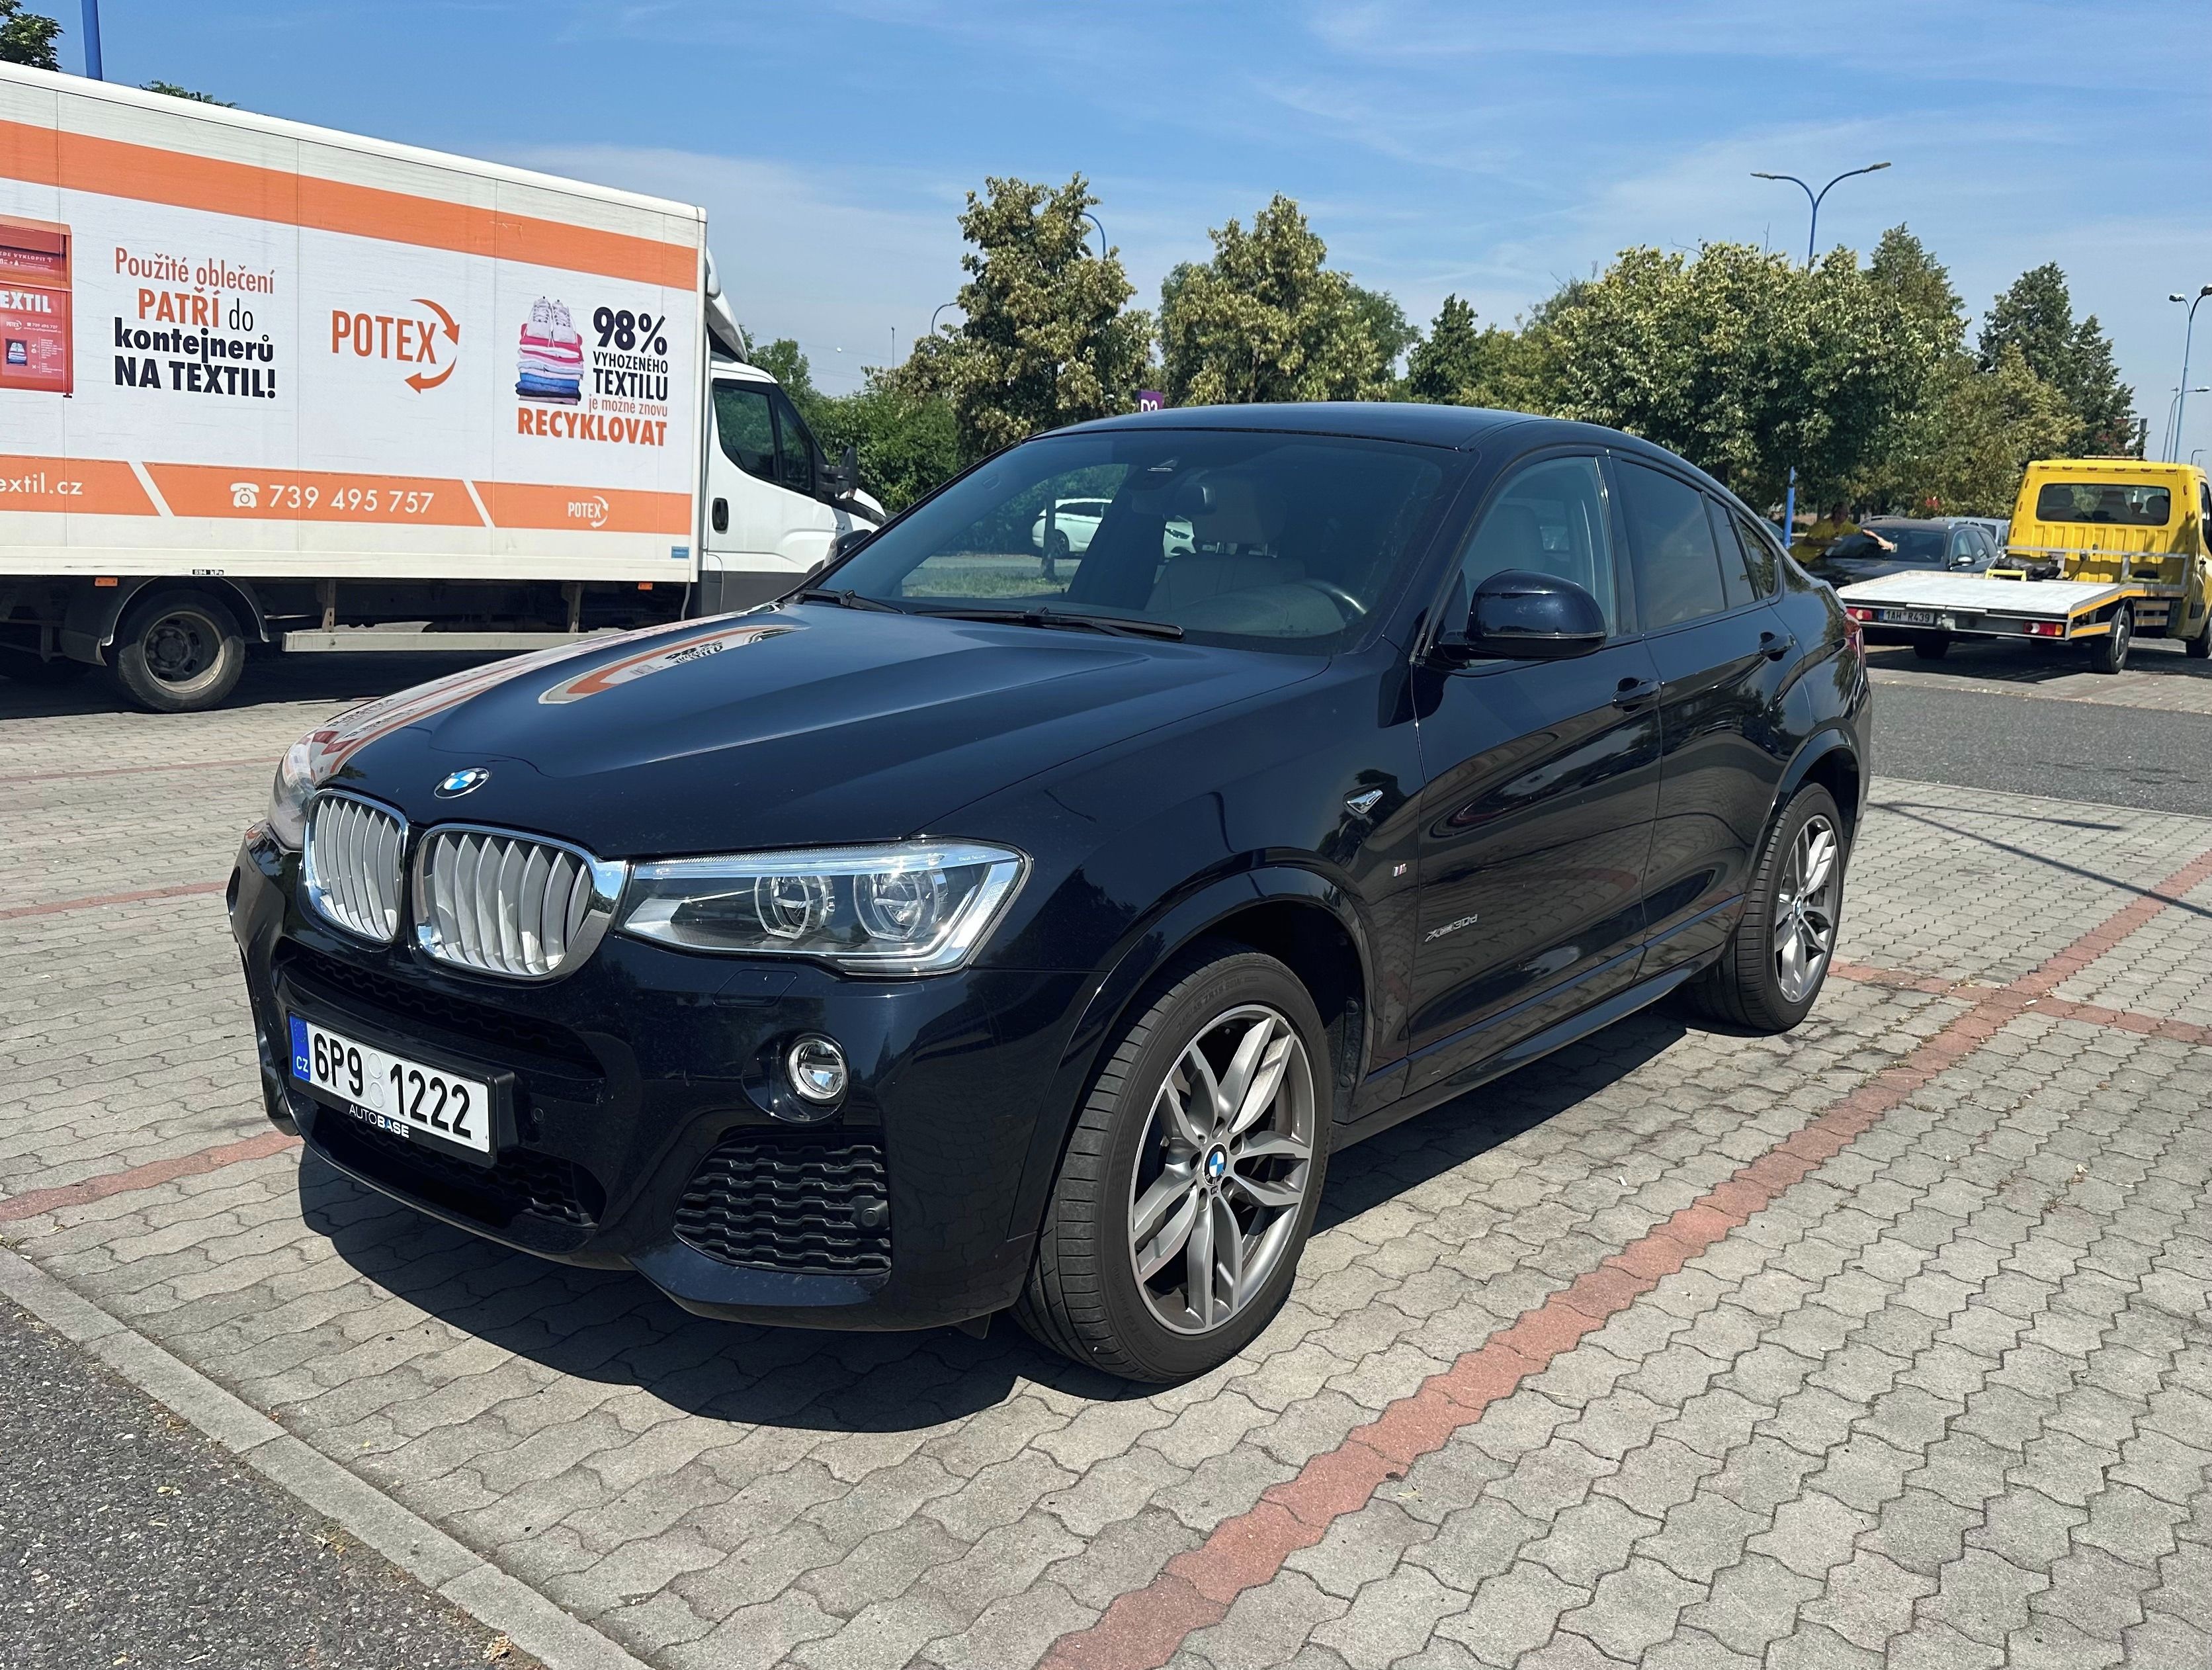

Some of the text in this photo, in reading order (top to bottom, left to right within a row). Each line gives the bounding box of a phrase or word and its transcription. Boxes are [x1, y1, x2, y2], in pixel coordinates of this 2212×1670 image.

[115, 247, 275, 294] Použité oblečení
[138, 286, 253, 331] PATŘÍ do
[114, 316, 274, 363] kontejnerů
[332, 310, 437, 365] POTEX
[593, 306, 667, 356] 98%
[114, 355, 276, 399] NA TEXTIL!
[593, 351, 668, 374] VYHOZENÉHO
[593, 367, 668, 401] TEXTILU
[589, 393, 667, 417] je možné znovu
[517, 407, 667, 447] RECYKLOVAT
[269, 484, 435, 513] 739 495 757
[568, 502, 601, 519] POTEX
[1886, 611, 1902, 621] 1AH
[296, 1055, 309, 1073] CZ
[314, 1032, 472, 1140] 6P9 1222
[348, 1104, 410, 1139] AUTOBASE
